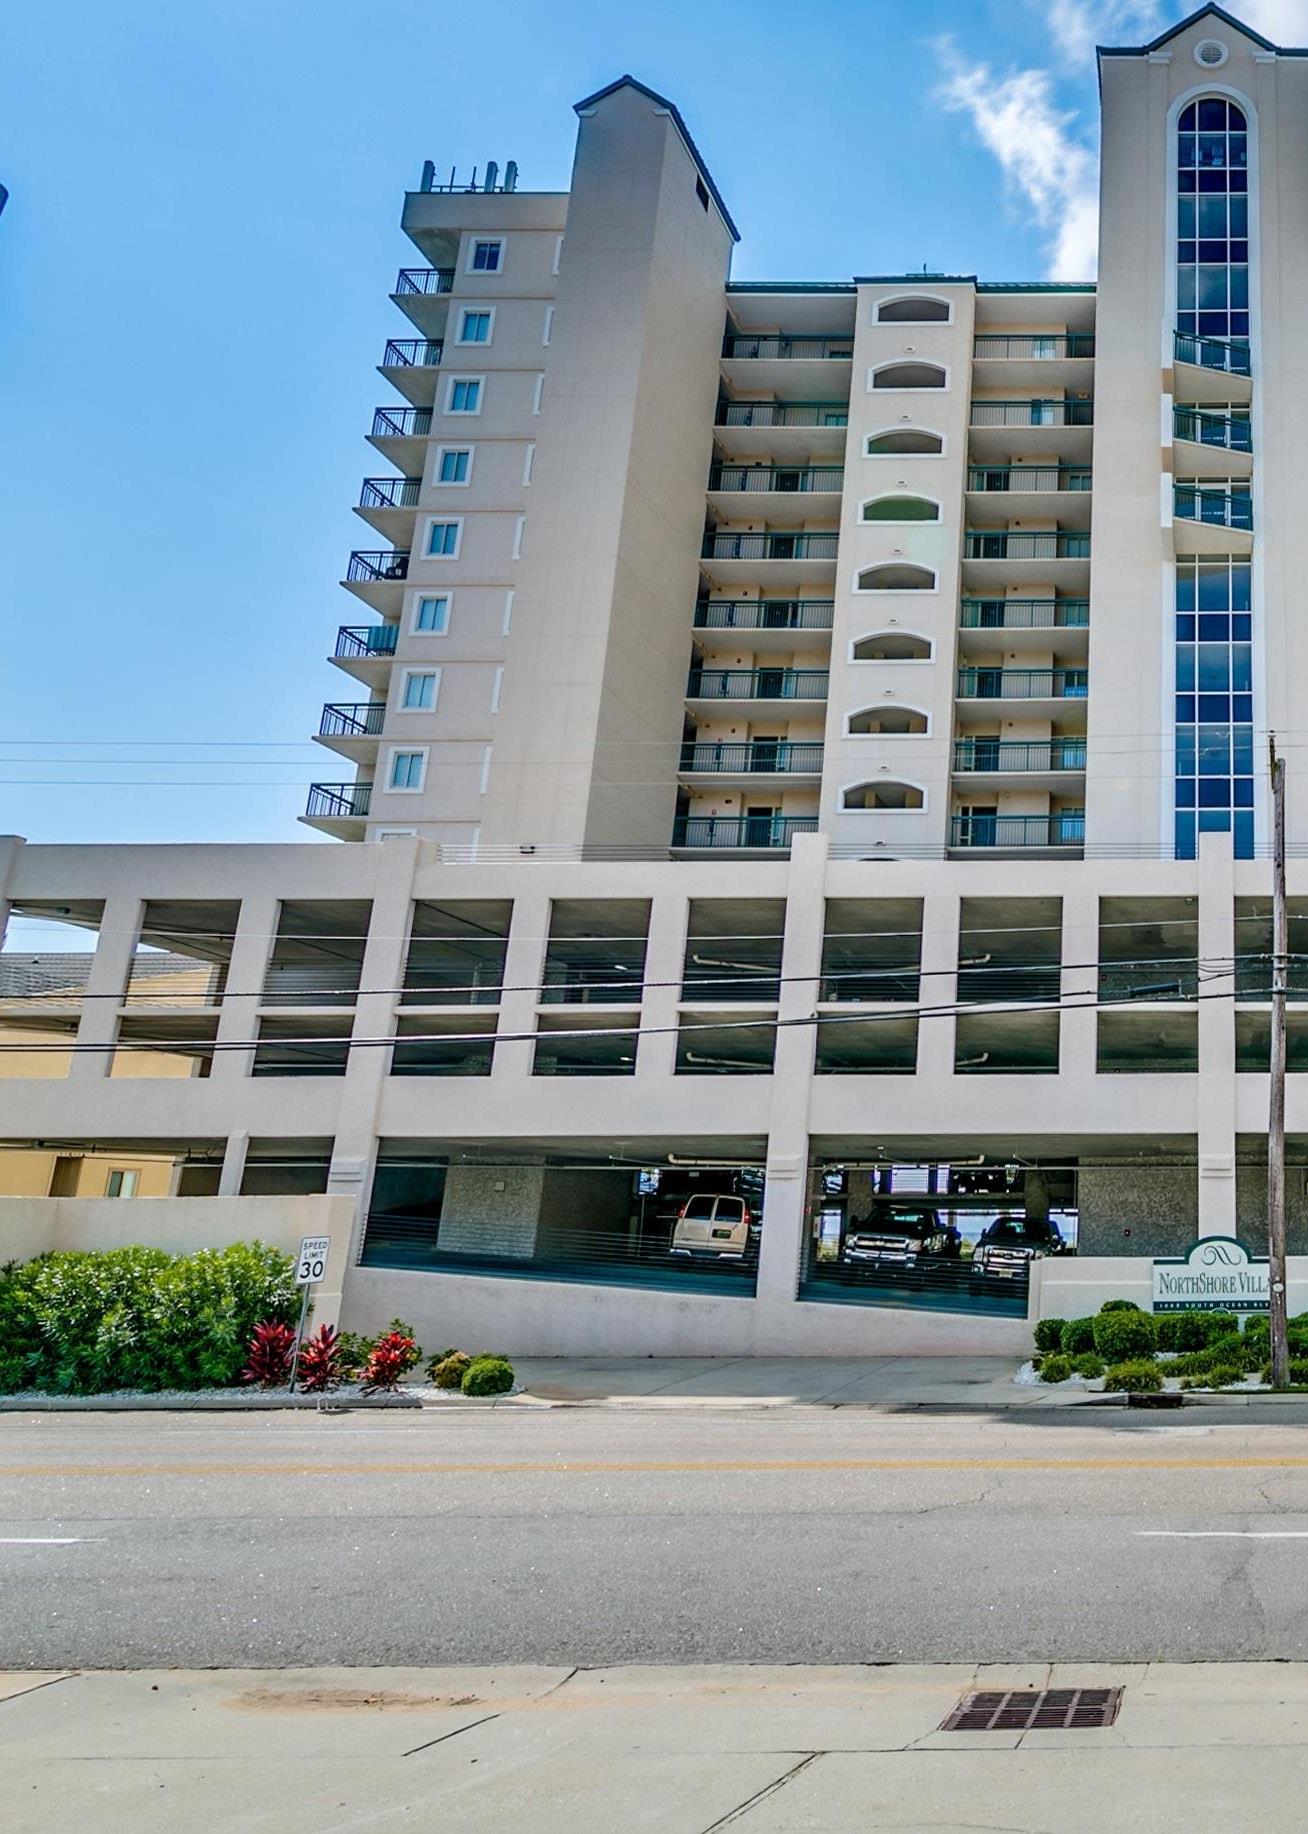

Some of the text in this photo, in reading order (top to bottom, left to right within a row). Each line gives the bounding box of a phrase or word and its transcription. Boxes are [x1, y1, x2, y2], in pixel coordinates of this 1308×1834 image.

[303, 1241, 328, 1250] SPEED
[304, 1250, 324, 1259] LIMIT
[300, 1260, 324, 1279] 30
[1219, 1301, 1248, 1309] OCEAN
